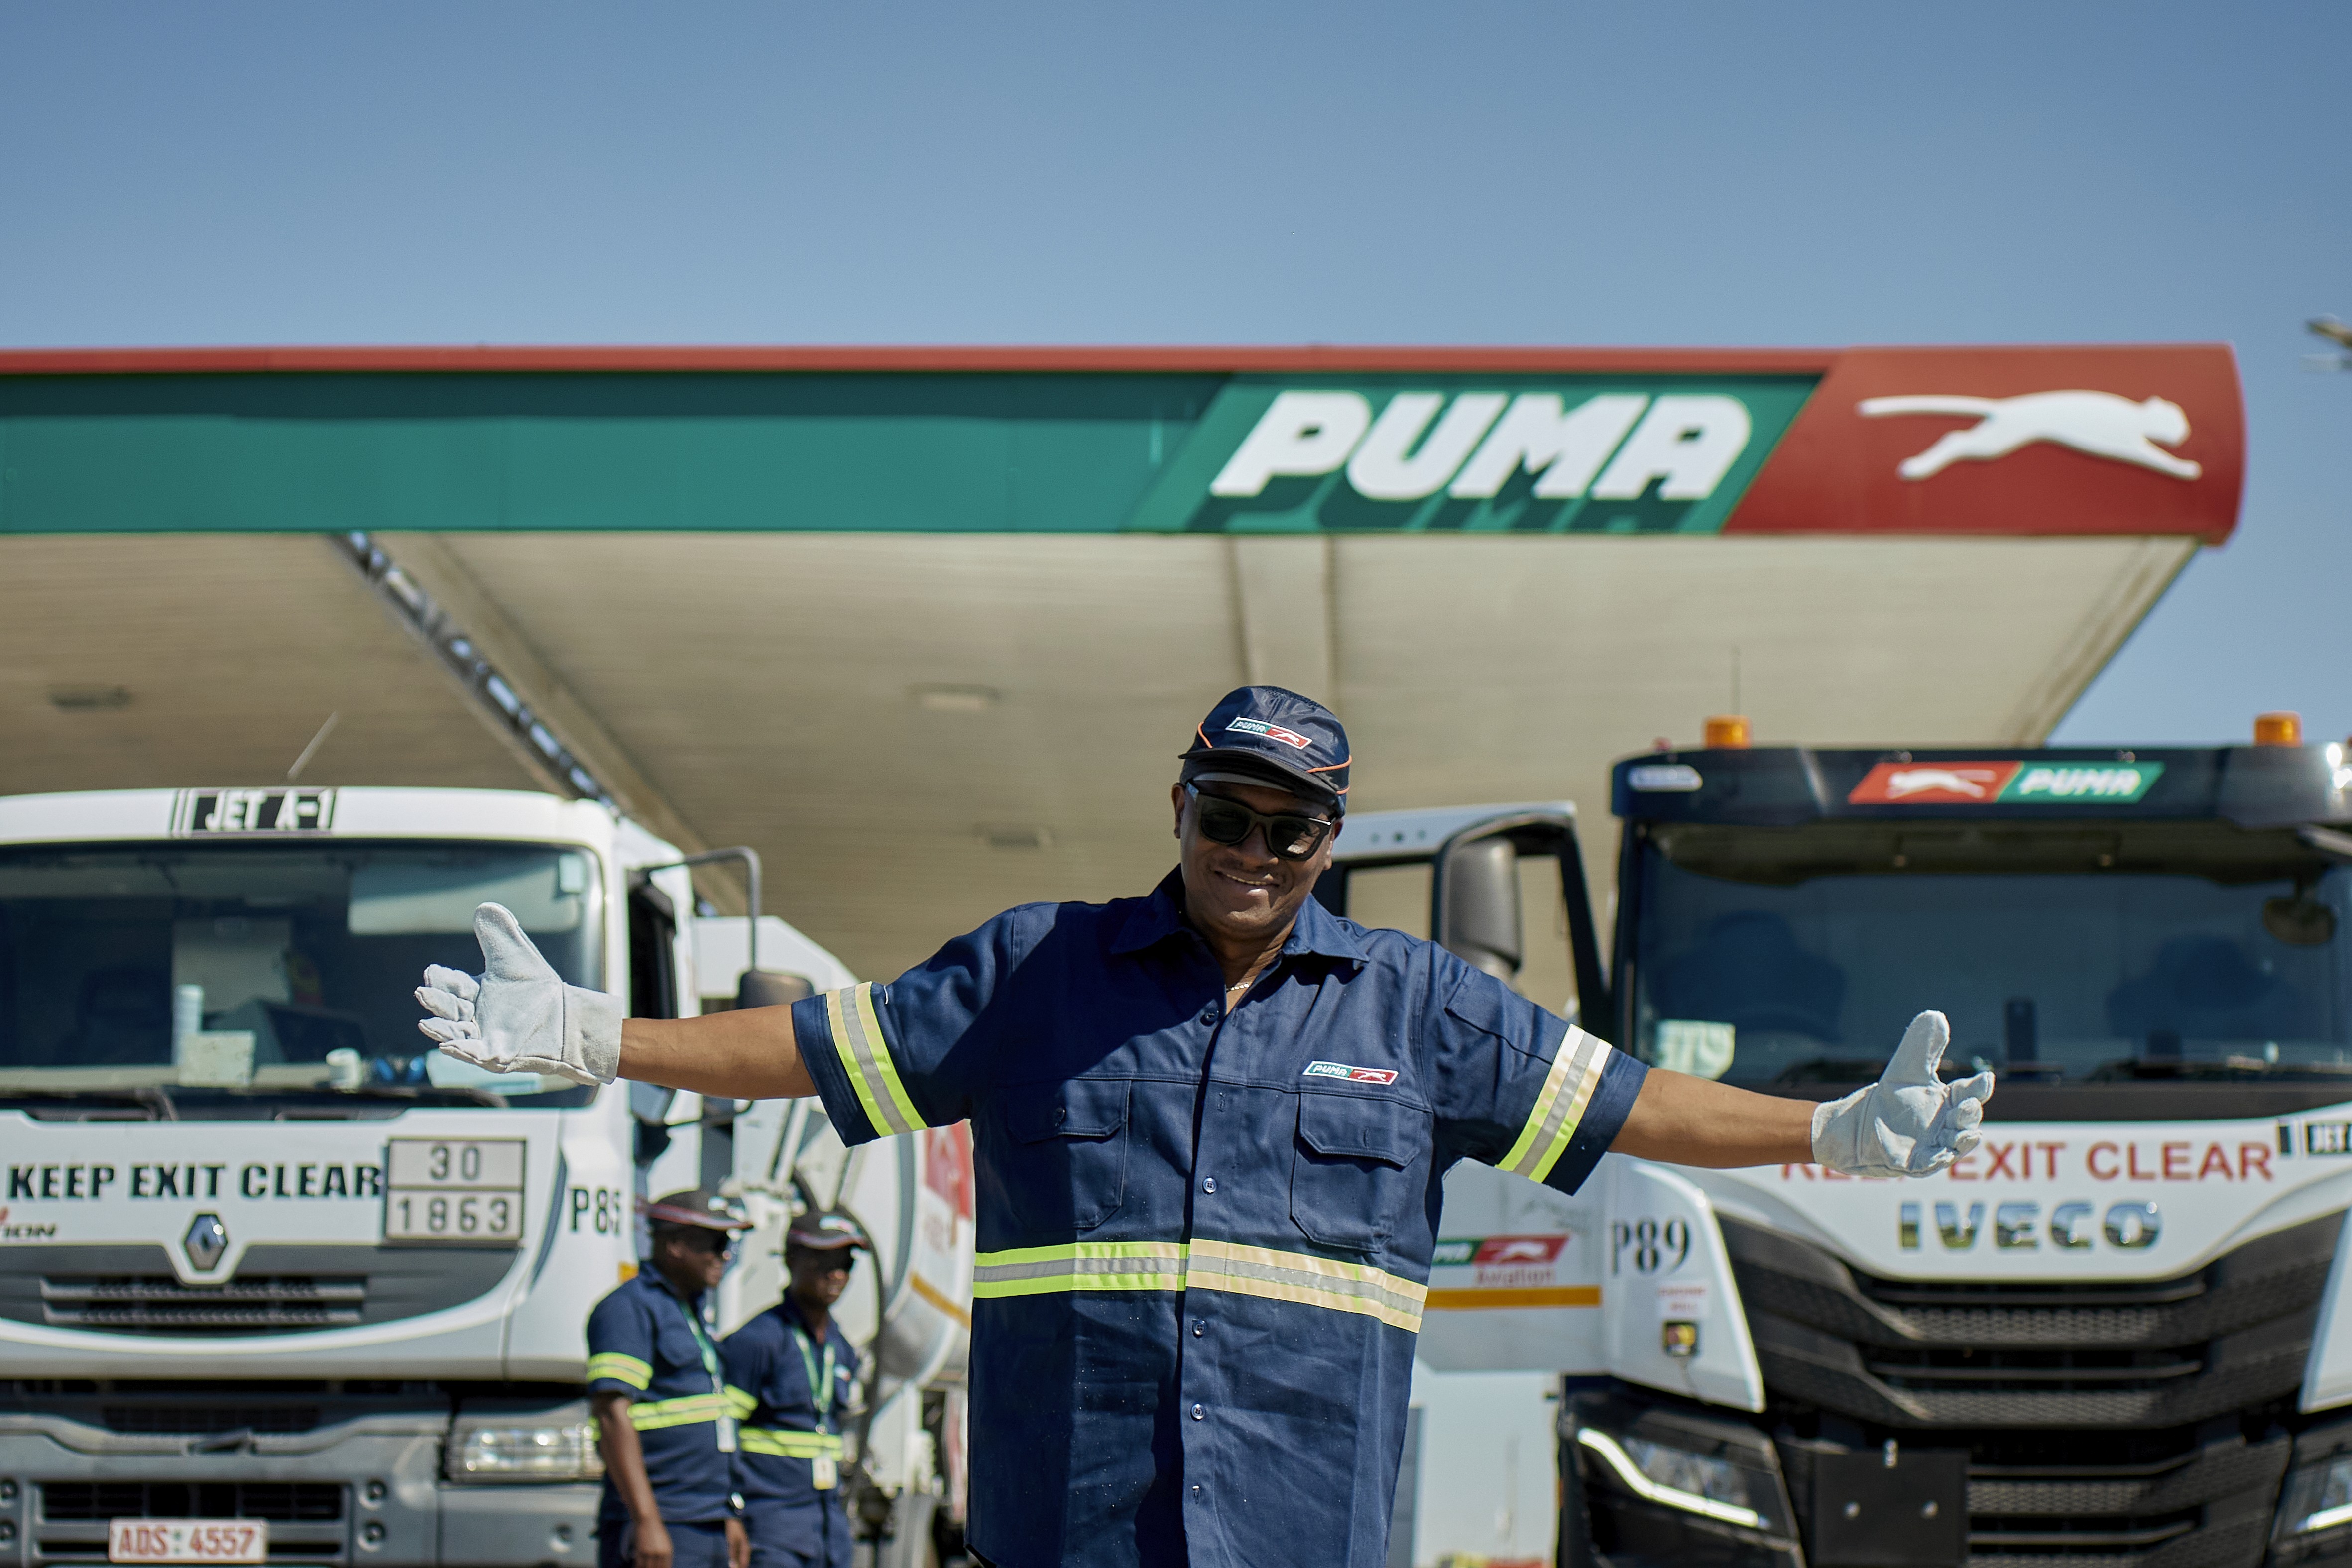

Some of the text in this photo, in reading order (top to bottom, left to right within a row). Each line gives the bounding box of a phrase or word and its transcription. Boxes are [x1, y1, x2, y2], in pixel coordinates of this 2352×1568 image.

[1209, 390, 1751, 499] PUMA
[1234, 721, 1266, 732] PUMA
[2019, 768, 2141, 796] PUMA
[205, 789, 334, 831] JET A-1
[1313, 1065, 1347, 1077] PUMA
[428, 1145, 481, 1181] 30
[1947, 1141, 2066, 1180] EXIT
[2085, 1141, 2273, 1181] CLEAR
[8, 1163, 381, 1199] KEEP EXIT CLEAR
[398, 1196, 510, 1232] 1863
[1899, 1200, 2162, 1250] IVECO
[1611, 1216, 1690, 1277] P89
[118, 1526, 254, 1555] ADS 4557
